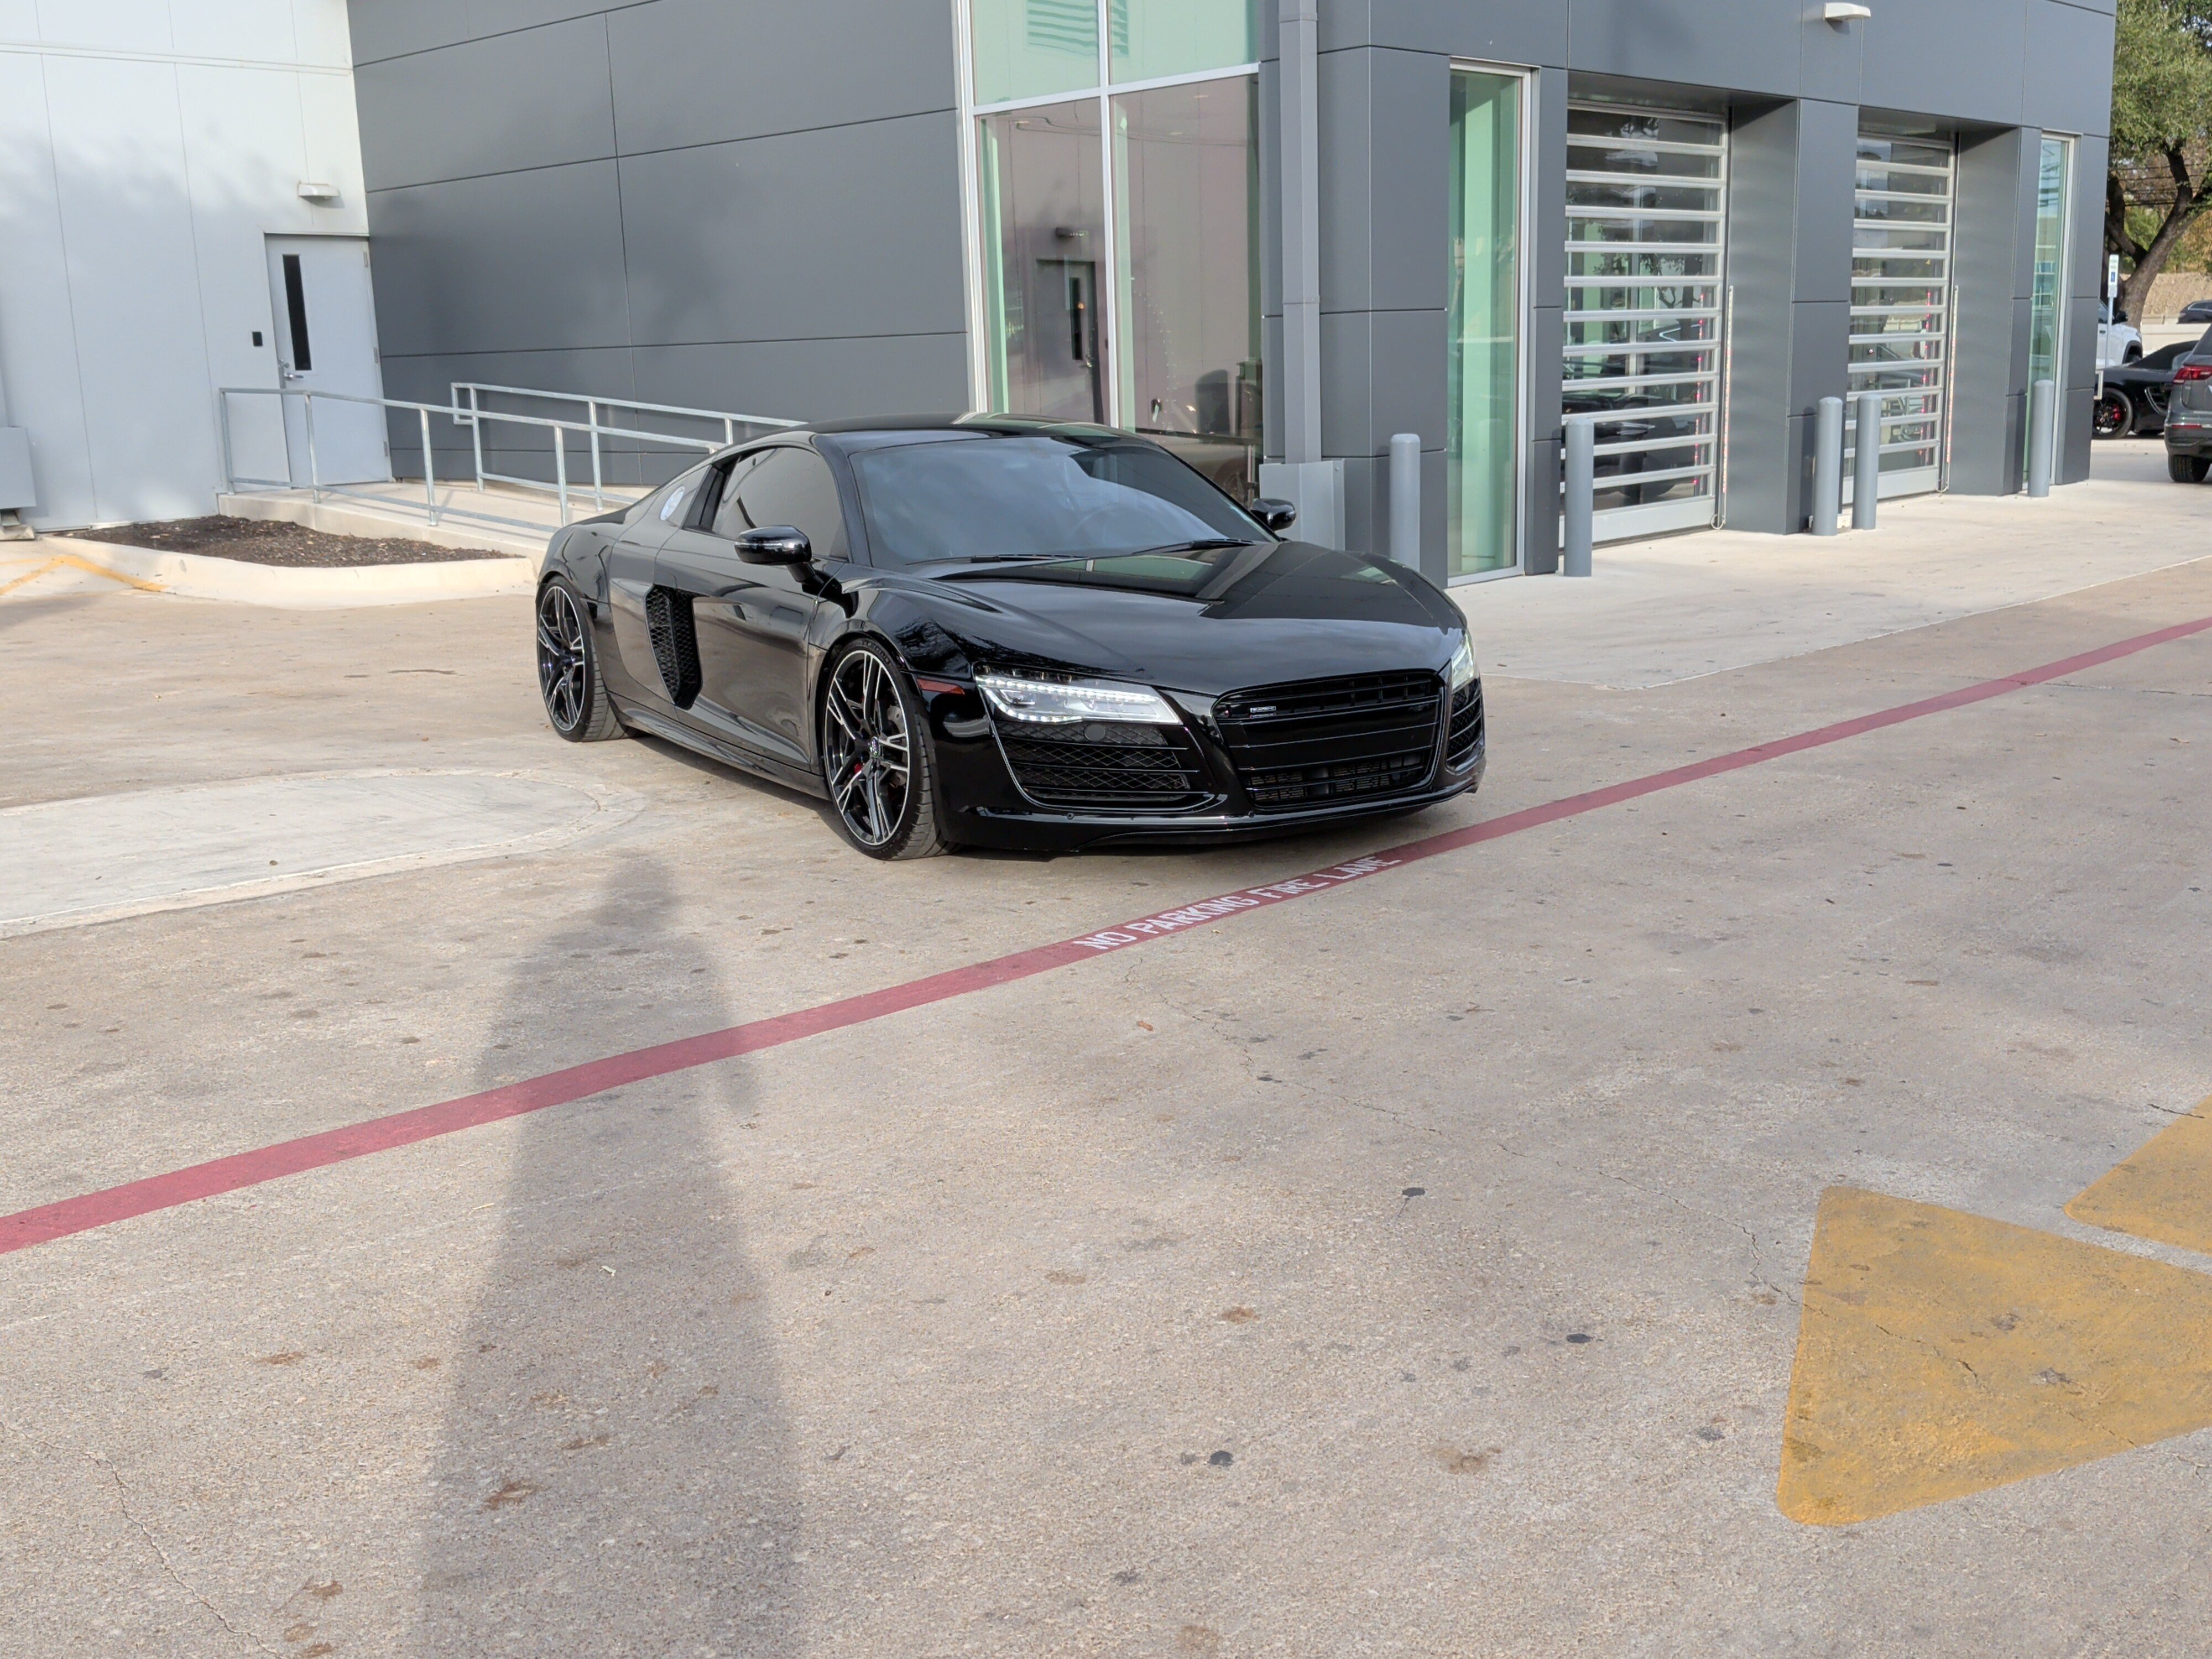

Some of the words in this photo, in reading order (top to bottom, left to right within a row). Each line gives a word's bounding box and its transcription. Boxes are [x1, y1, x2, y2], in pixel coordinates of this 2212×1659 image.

[1073, 932, 1137, 950] NO
[1124, 896, 1260, 935] PARKING
[1246, 879, 1330, 899] FIRE
[1313, 856, 1402, 879] LANE
